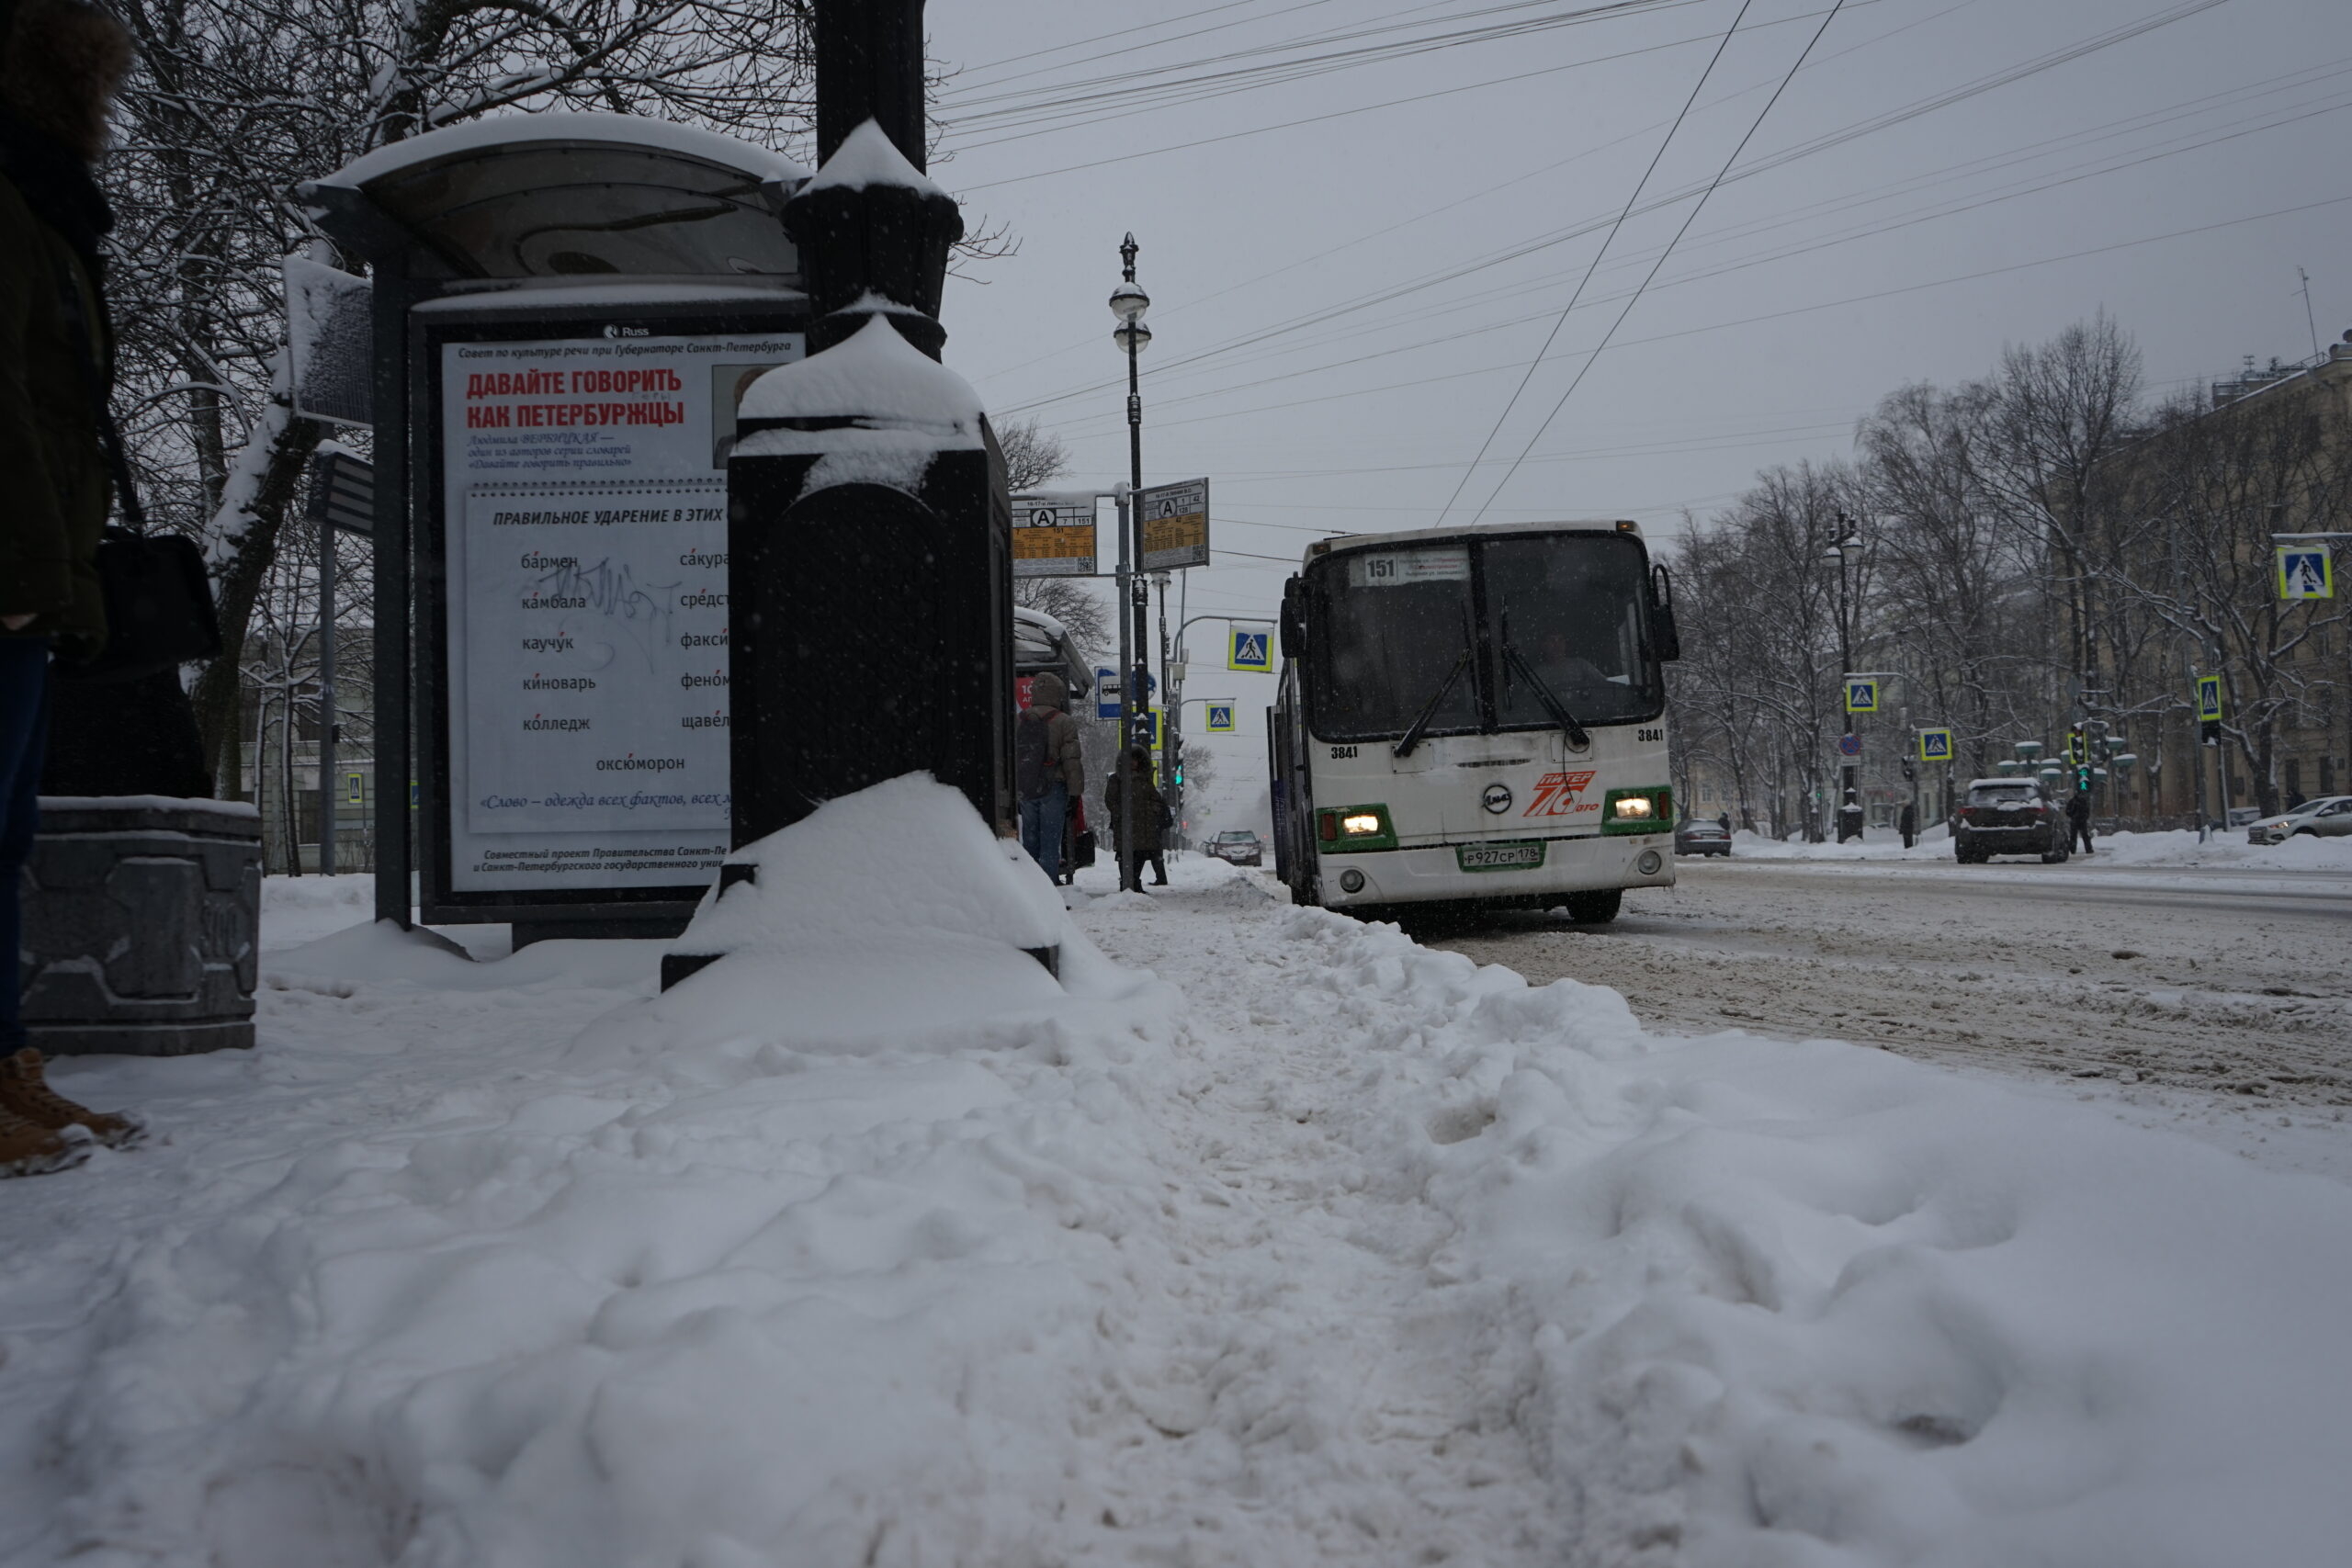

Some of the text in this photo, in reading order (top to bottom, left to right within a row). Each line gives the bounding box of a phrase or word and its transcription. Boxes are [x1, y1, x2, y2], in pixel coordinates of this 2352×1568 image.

[622, 327, 650, 337] Russ
[458, 341, 791, 359] Совет по культуре речи при Губернаторе Санкт-Петербурга
[467, 368, 682, 399] ДАВАЙТЕ ГОВОРИТЬ
[467, 401, 684, 428] КАК ПЕТЕРБУРЖЦЫ
[467, 433, 518, 446] Людмила
[468, 445, 631, 459] один из авторов серии словарей
[522, 458, 571, 471] говорить
[492, 511, 590, 525] ПРАВИЛЬНОЕ
[593, 509, 669, 525] УДАРЕНИЕ
[673, 509, 683, 522] В
[684, 508, 724, 522] ЭТИХ
[1367, 559, 1394, 577] 151
[1638, 728, 1663, 741] 3841
[1331, 745, 1358, 760] 3841
[1539, 773, 1592, 784] ПИТЕР
[479, 795, 527, 809] «Слово
[544, 792, 594, 809] одежда
[598, 794, 629, 808] всех
[629, 790, 687, 810] фактов,
[691, 793, 722, 806] всех
[484, 849, 549, 860] Совместный
[551, 849, 591, 860] проект
[593, 847, 674, 859] Правительства
[481, 861, 602, 873] Санкт-Петербургского
[604, 859, 697, 872] государственного
